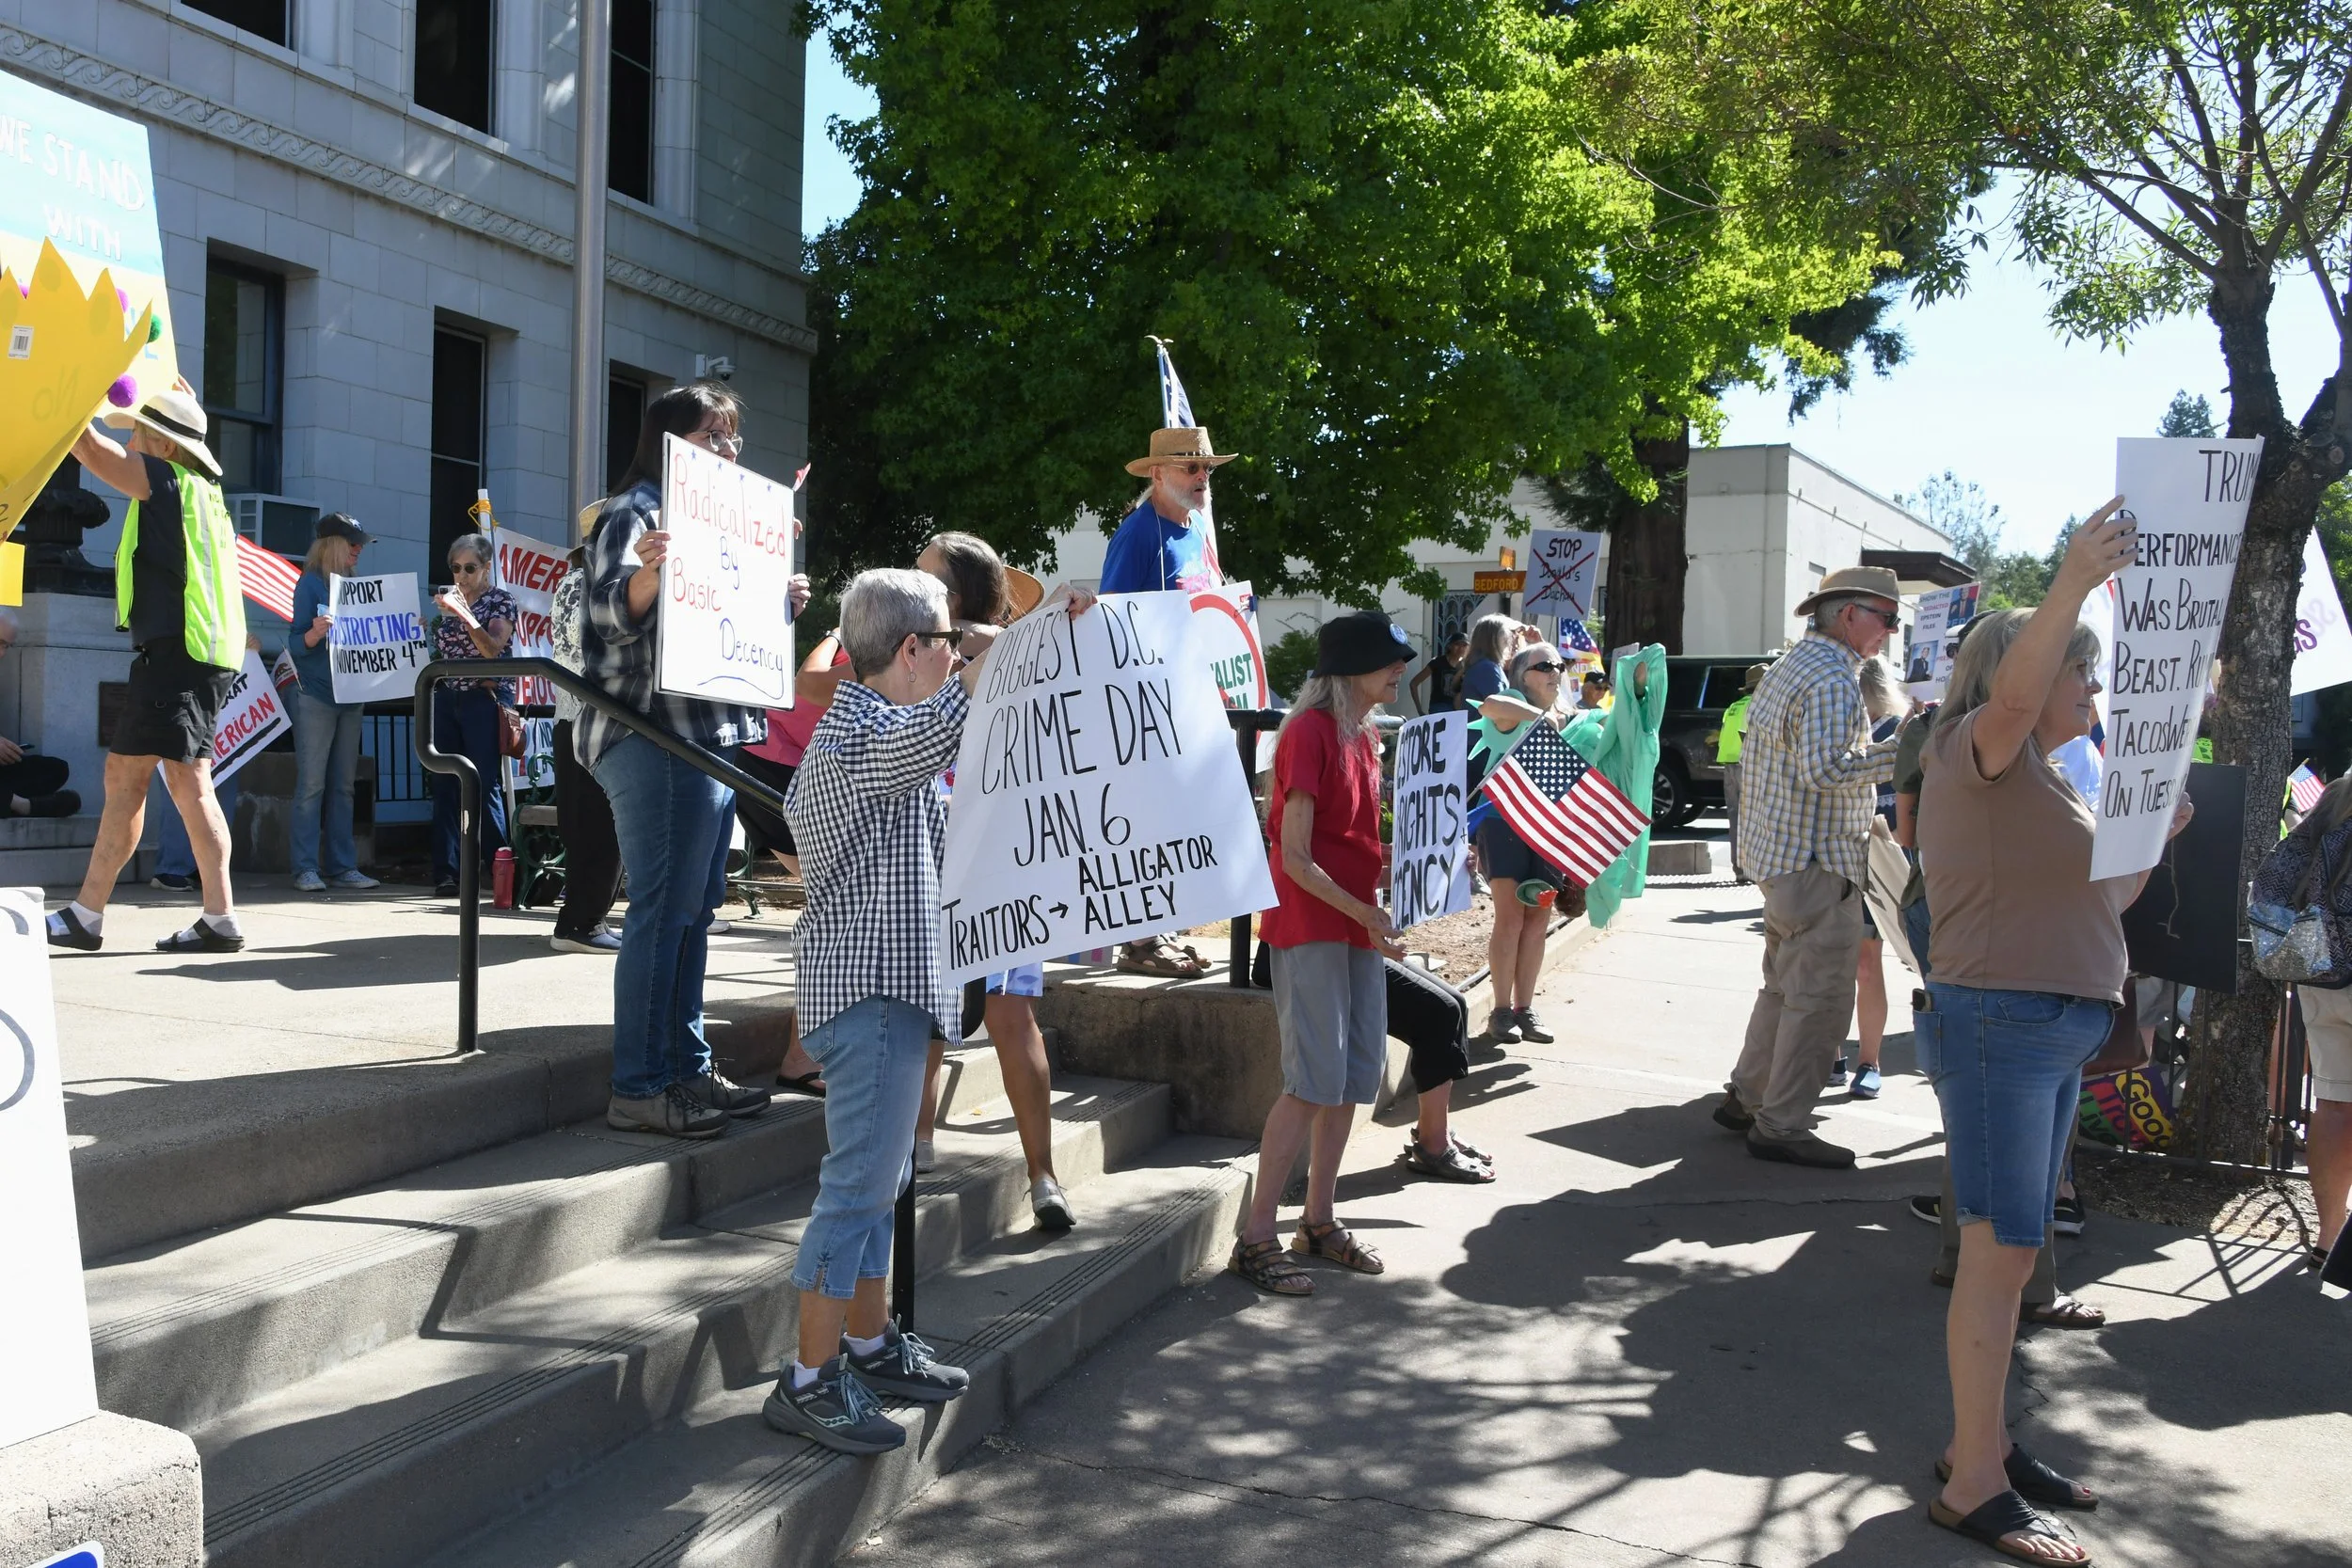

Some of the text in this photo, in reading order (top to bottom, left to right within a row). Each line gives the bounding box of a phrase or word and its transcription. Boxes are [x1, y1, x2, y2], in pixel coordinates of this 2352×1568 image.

[42, 132, 146, 211] STAND
[43, 203, 122, 261] WITH
[673, 452, 786, 561] Radicalized
[719, 535, 739, 591] By
[1546, 537, 1582, 561] STOP
[670, 556, 723, 612] Basic
[1474, 578, 1519, 591] BEDFORD
[2117, 577, 2170, 633] WAS
[336, 647, 398, 674] NOVEMBER
[718, 617, 785, 699] Decency
[1099, 600, 1165, 671] D.C.
[981, 677, 1183, 796] CRIME DAY
[2105, 769, 2133, 818] ON
[1013, 782, 1131, 867] JAN. 6
[1078, 833, 1218, 896] ALLIGATOR
[941, 879, 1178, 971] TRAITORS ALLEY
